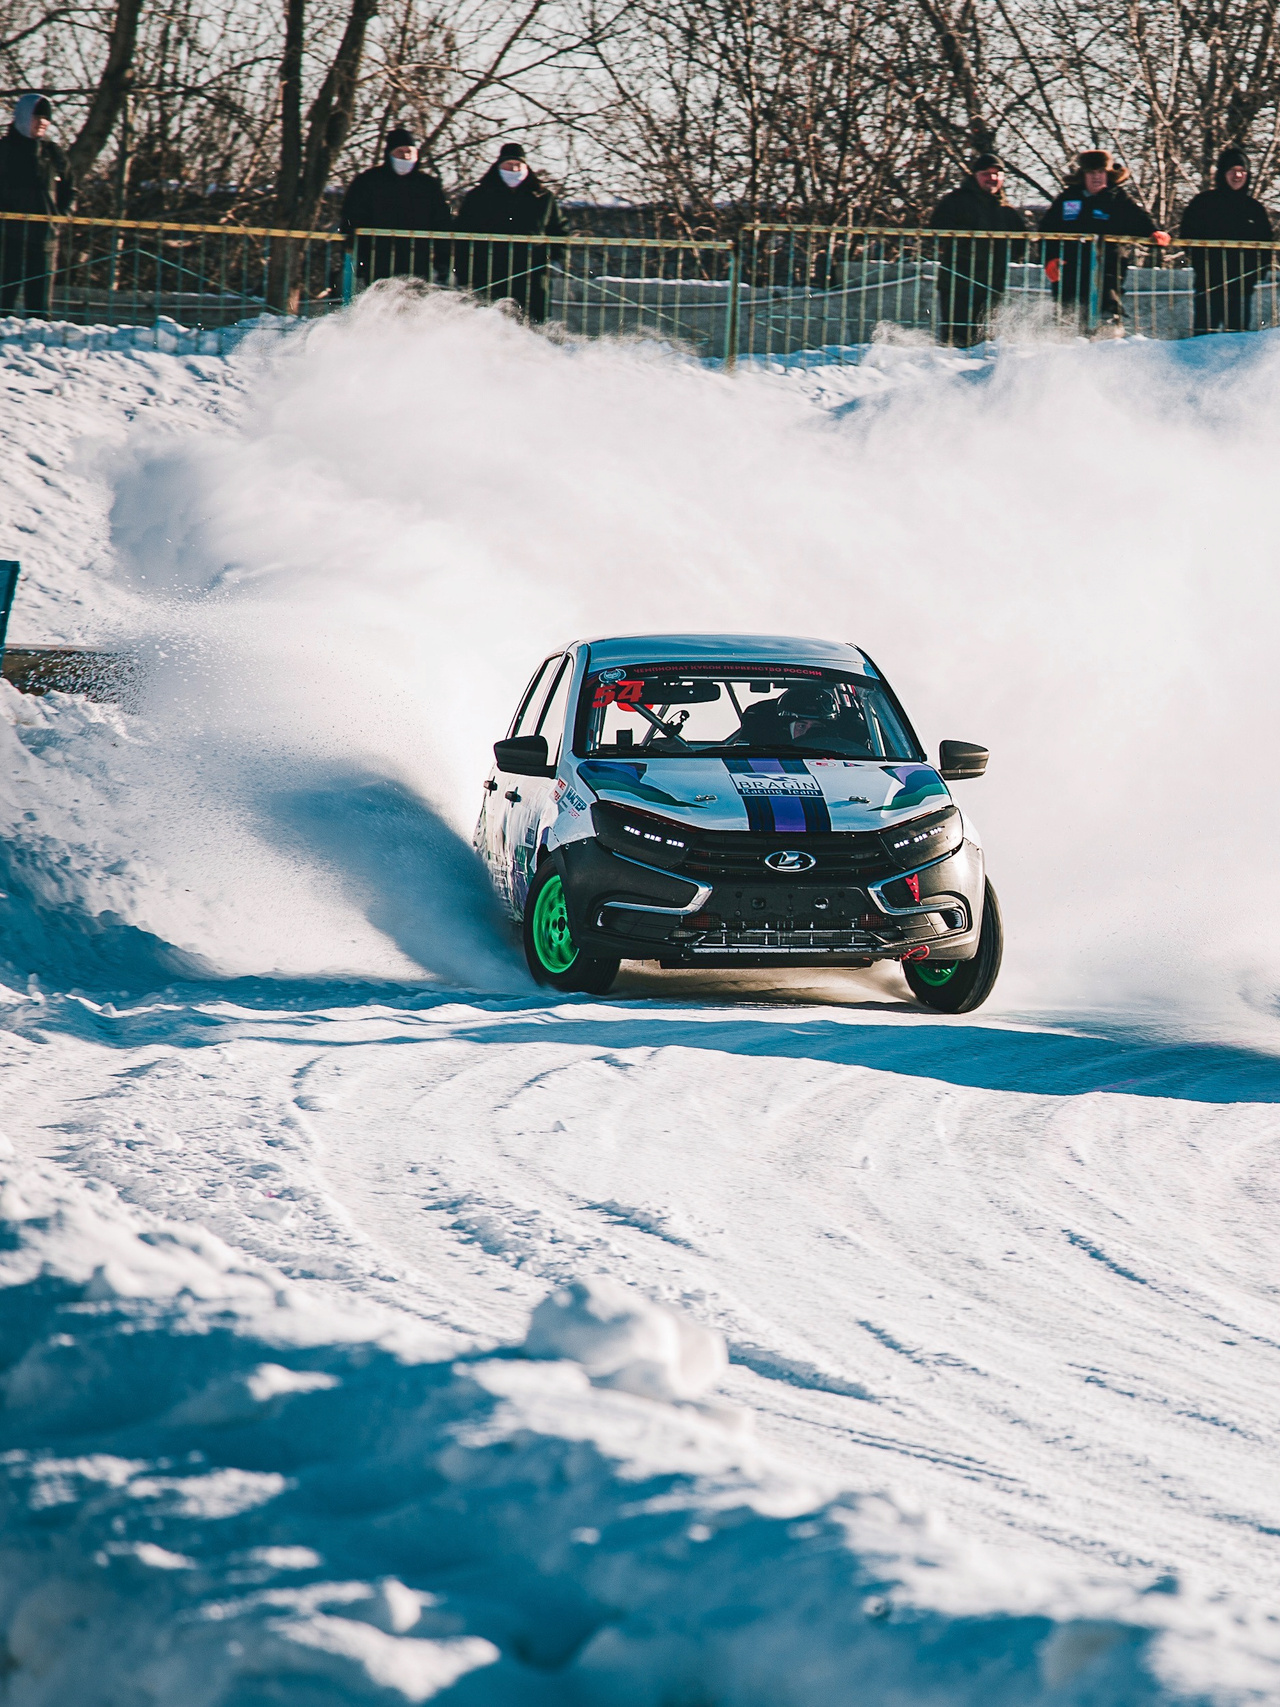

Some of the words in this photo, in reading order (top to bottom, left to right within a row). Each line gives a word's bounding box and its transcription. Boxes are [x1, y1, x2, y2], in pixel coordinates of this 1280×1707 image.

[634, 665, 688, 674] ЧЕМПИОНАТ
[724, 665, 780, 673] ПЕРВЕНСТВО
[783, 668, 823, 677] РОССИИ
[592, 682, 643, 708] 54
[739, 780, 816, 790] BRAGIN
